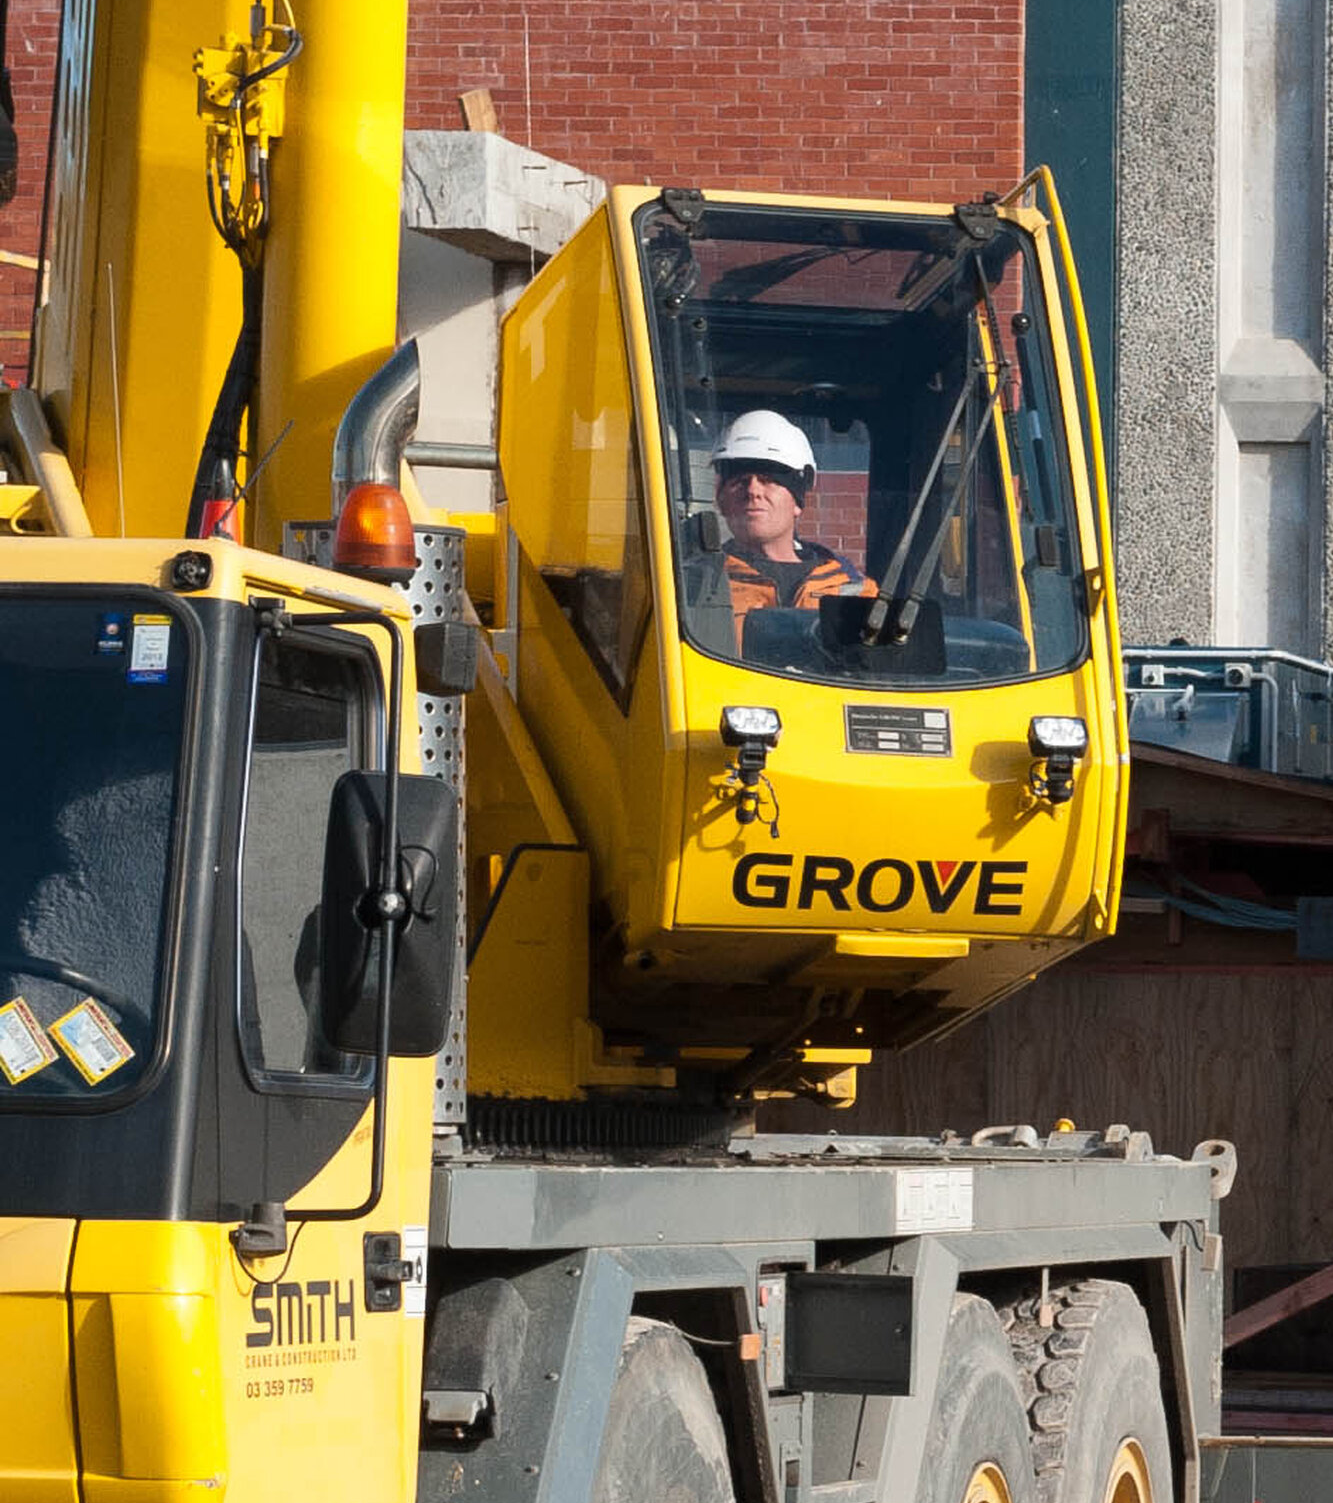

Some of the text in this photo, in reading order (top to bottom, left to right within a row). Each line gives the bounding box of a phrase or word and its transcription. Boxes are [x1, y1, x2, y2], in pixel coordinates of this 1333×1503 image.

[732, 852, 1028, 915] GROVE
[246, 1279, 355, 1347] SMITH
[245, 1353, 272, 1369] CRANE
[246, 1377, 314, 1398] 03 359 7759
